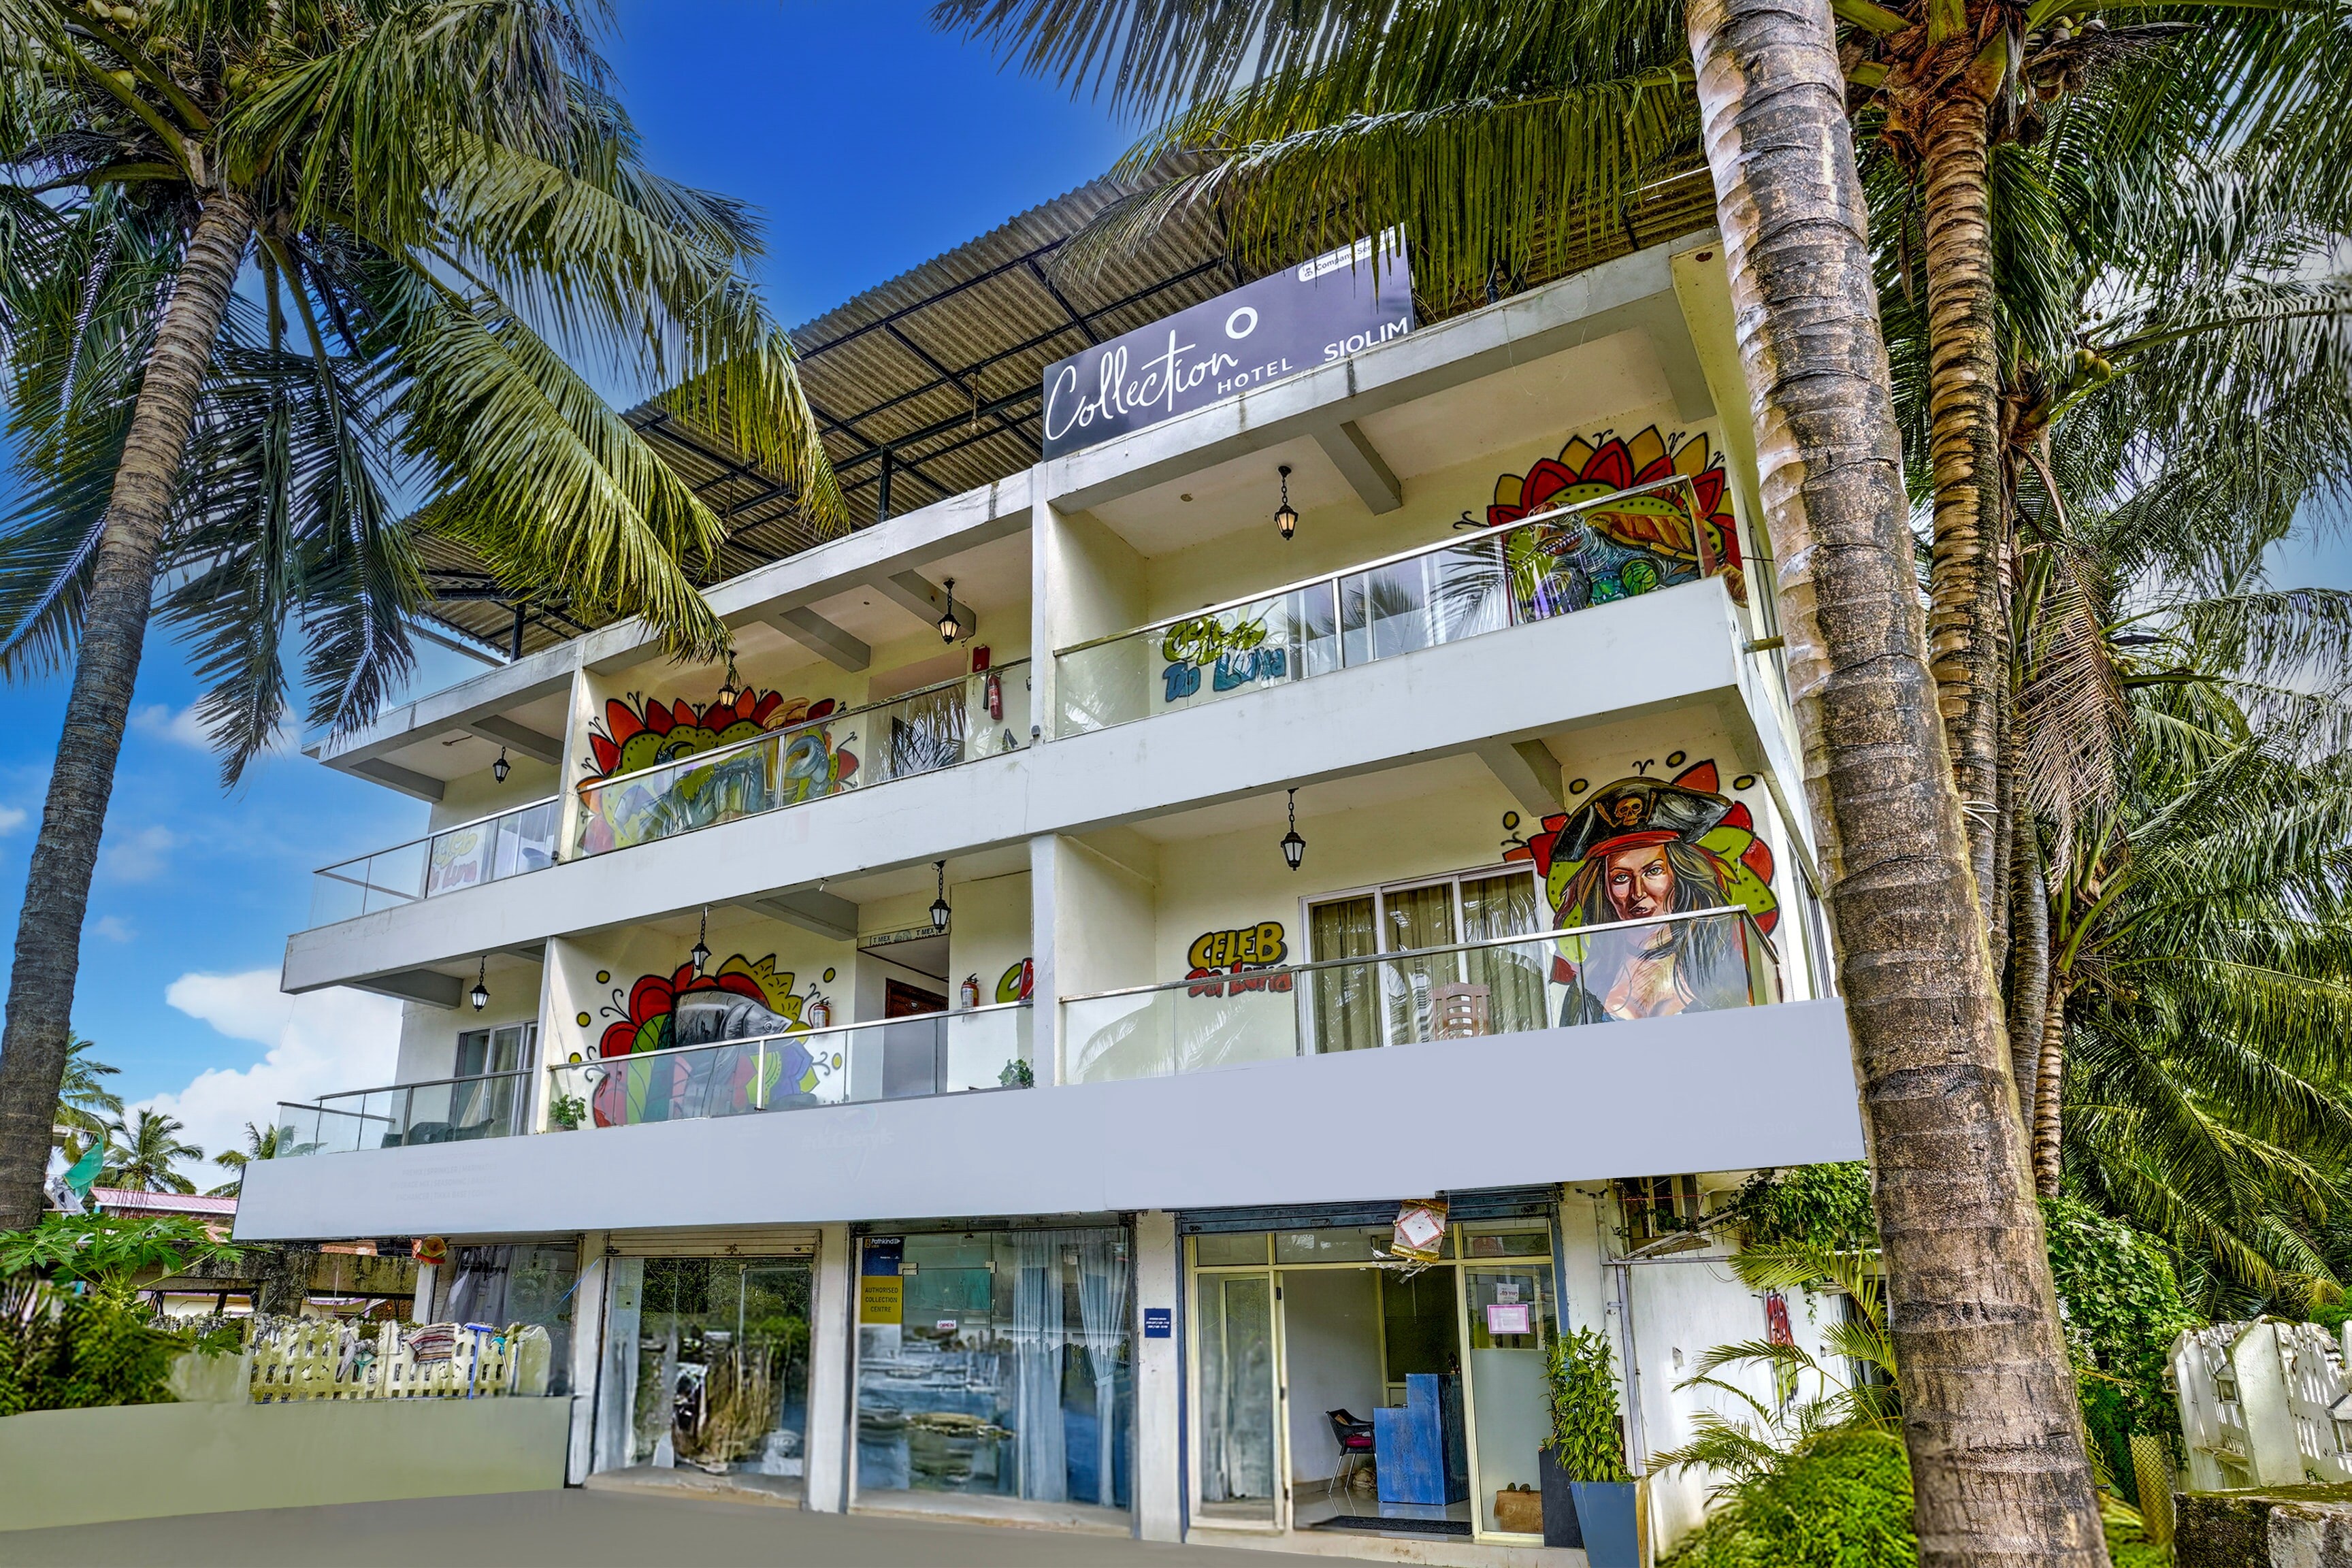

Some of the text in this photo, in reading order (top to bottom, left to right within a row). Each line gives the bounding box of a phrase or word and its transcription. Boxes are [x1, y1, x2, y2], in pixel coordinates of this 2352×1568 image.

[1045, 329, 1239, 441] Collection
[1218, 316, 1408, 395] HOTEL SIOLIM
[1188, 921, 1288, 969] CELEB
